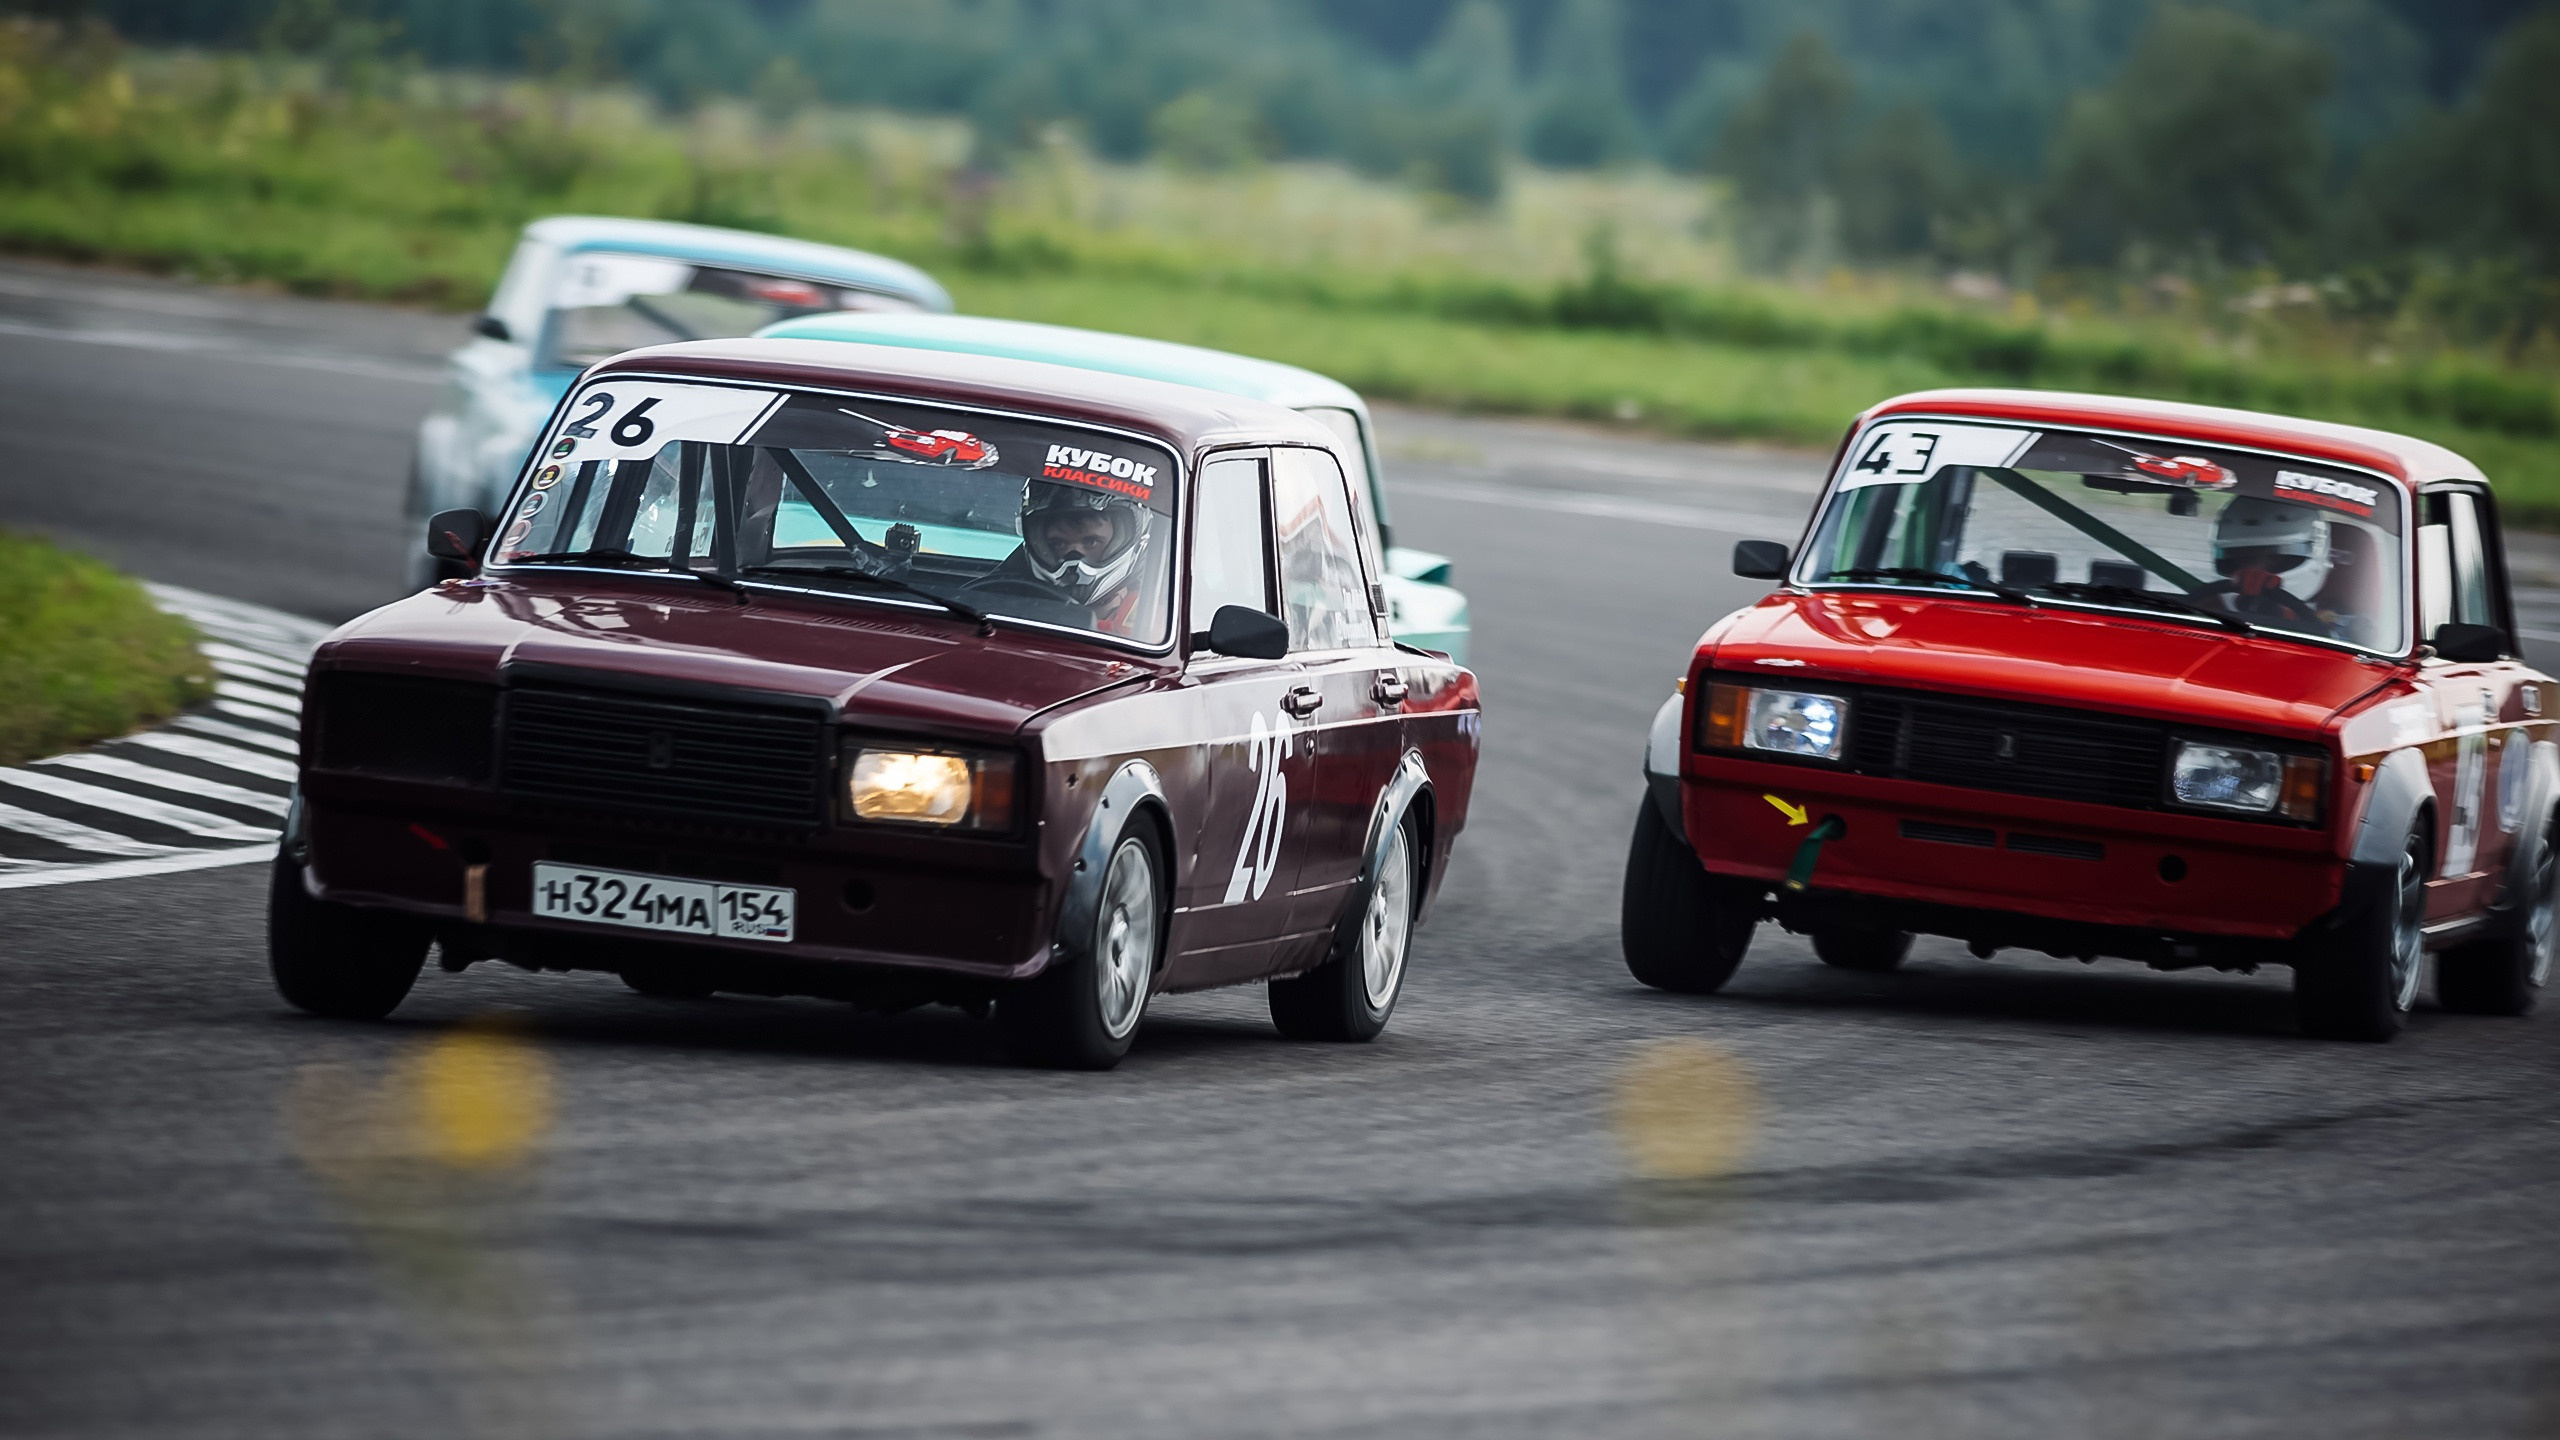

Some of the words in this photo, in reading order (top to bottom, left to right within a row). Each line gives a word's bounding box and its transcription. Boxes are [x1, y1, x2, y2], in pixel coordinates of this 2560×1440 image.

[563, 392, 663, 447] 26
[1045, 444, 1157, 487] КУБОК
[1855, 432, 1940, 475] 43
[1043, 466, 1150, 499] КЛАССИКИ
[1223, 710, 1293, 904] 26
[719, 890, 789, 925] 154
